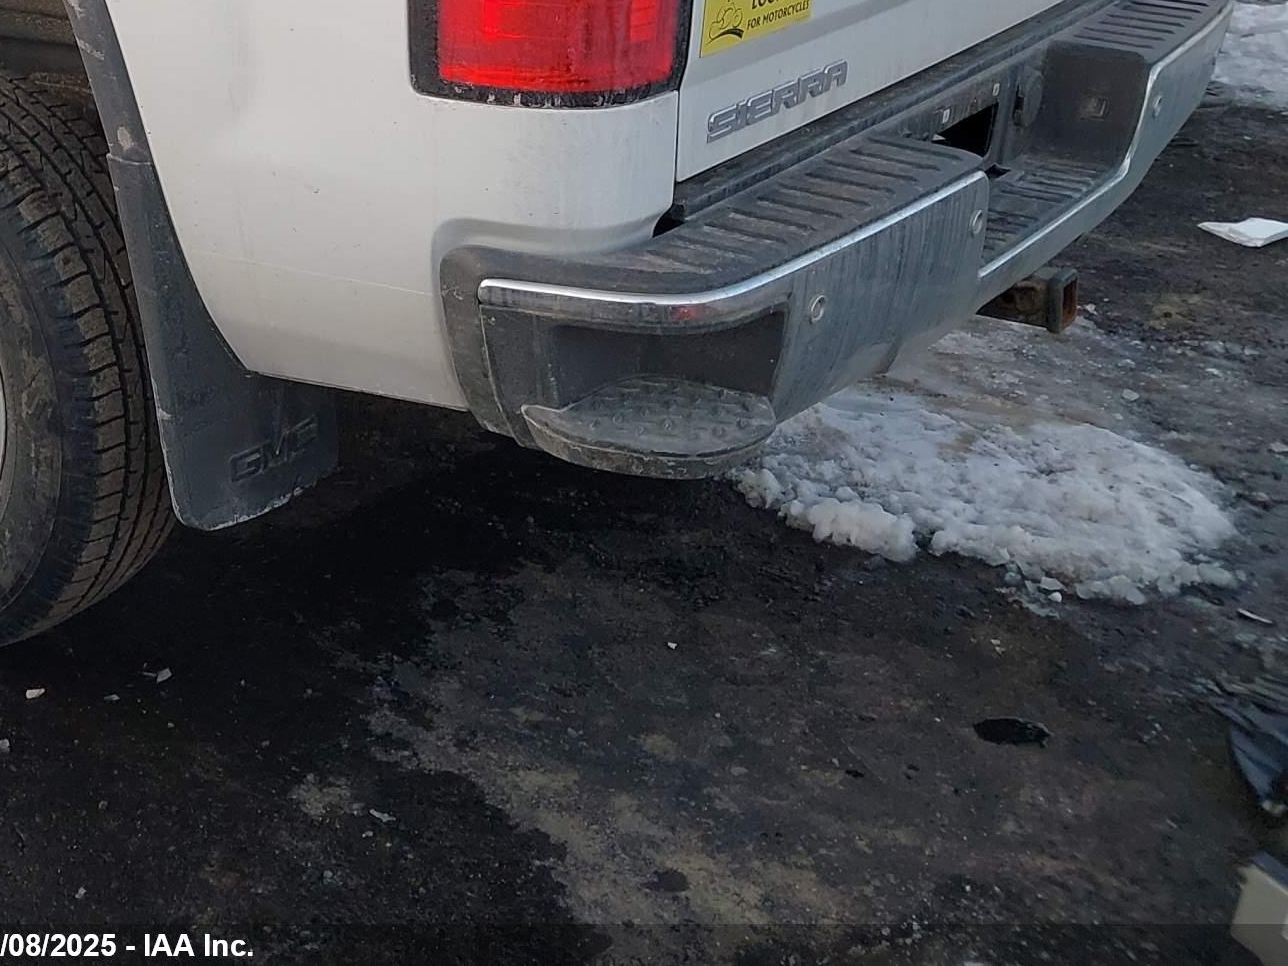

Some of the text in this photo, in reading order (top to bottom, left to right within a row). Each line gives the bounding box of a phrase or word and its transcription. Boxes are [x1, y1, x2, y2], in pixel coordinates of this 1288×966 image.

[747, 0, 810, 30] FOR MOTORCYCLES
[707, 59, 848, 143] SIERRA
